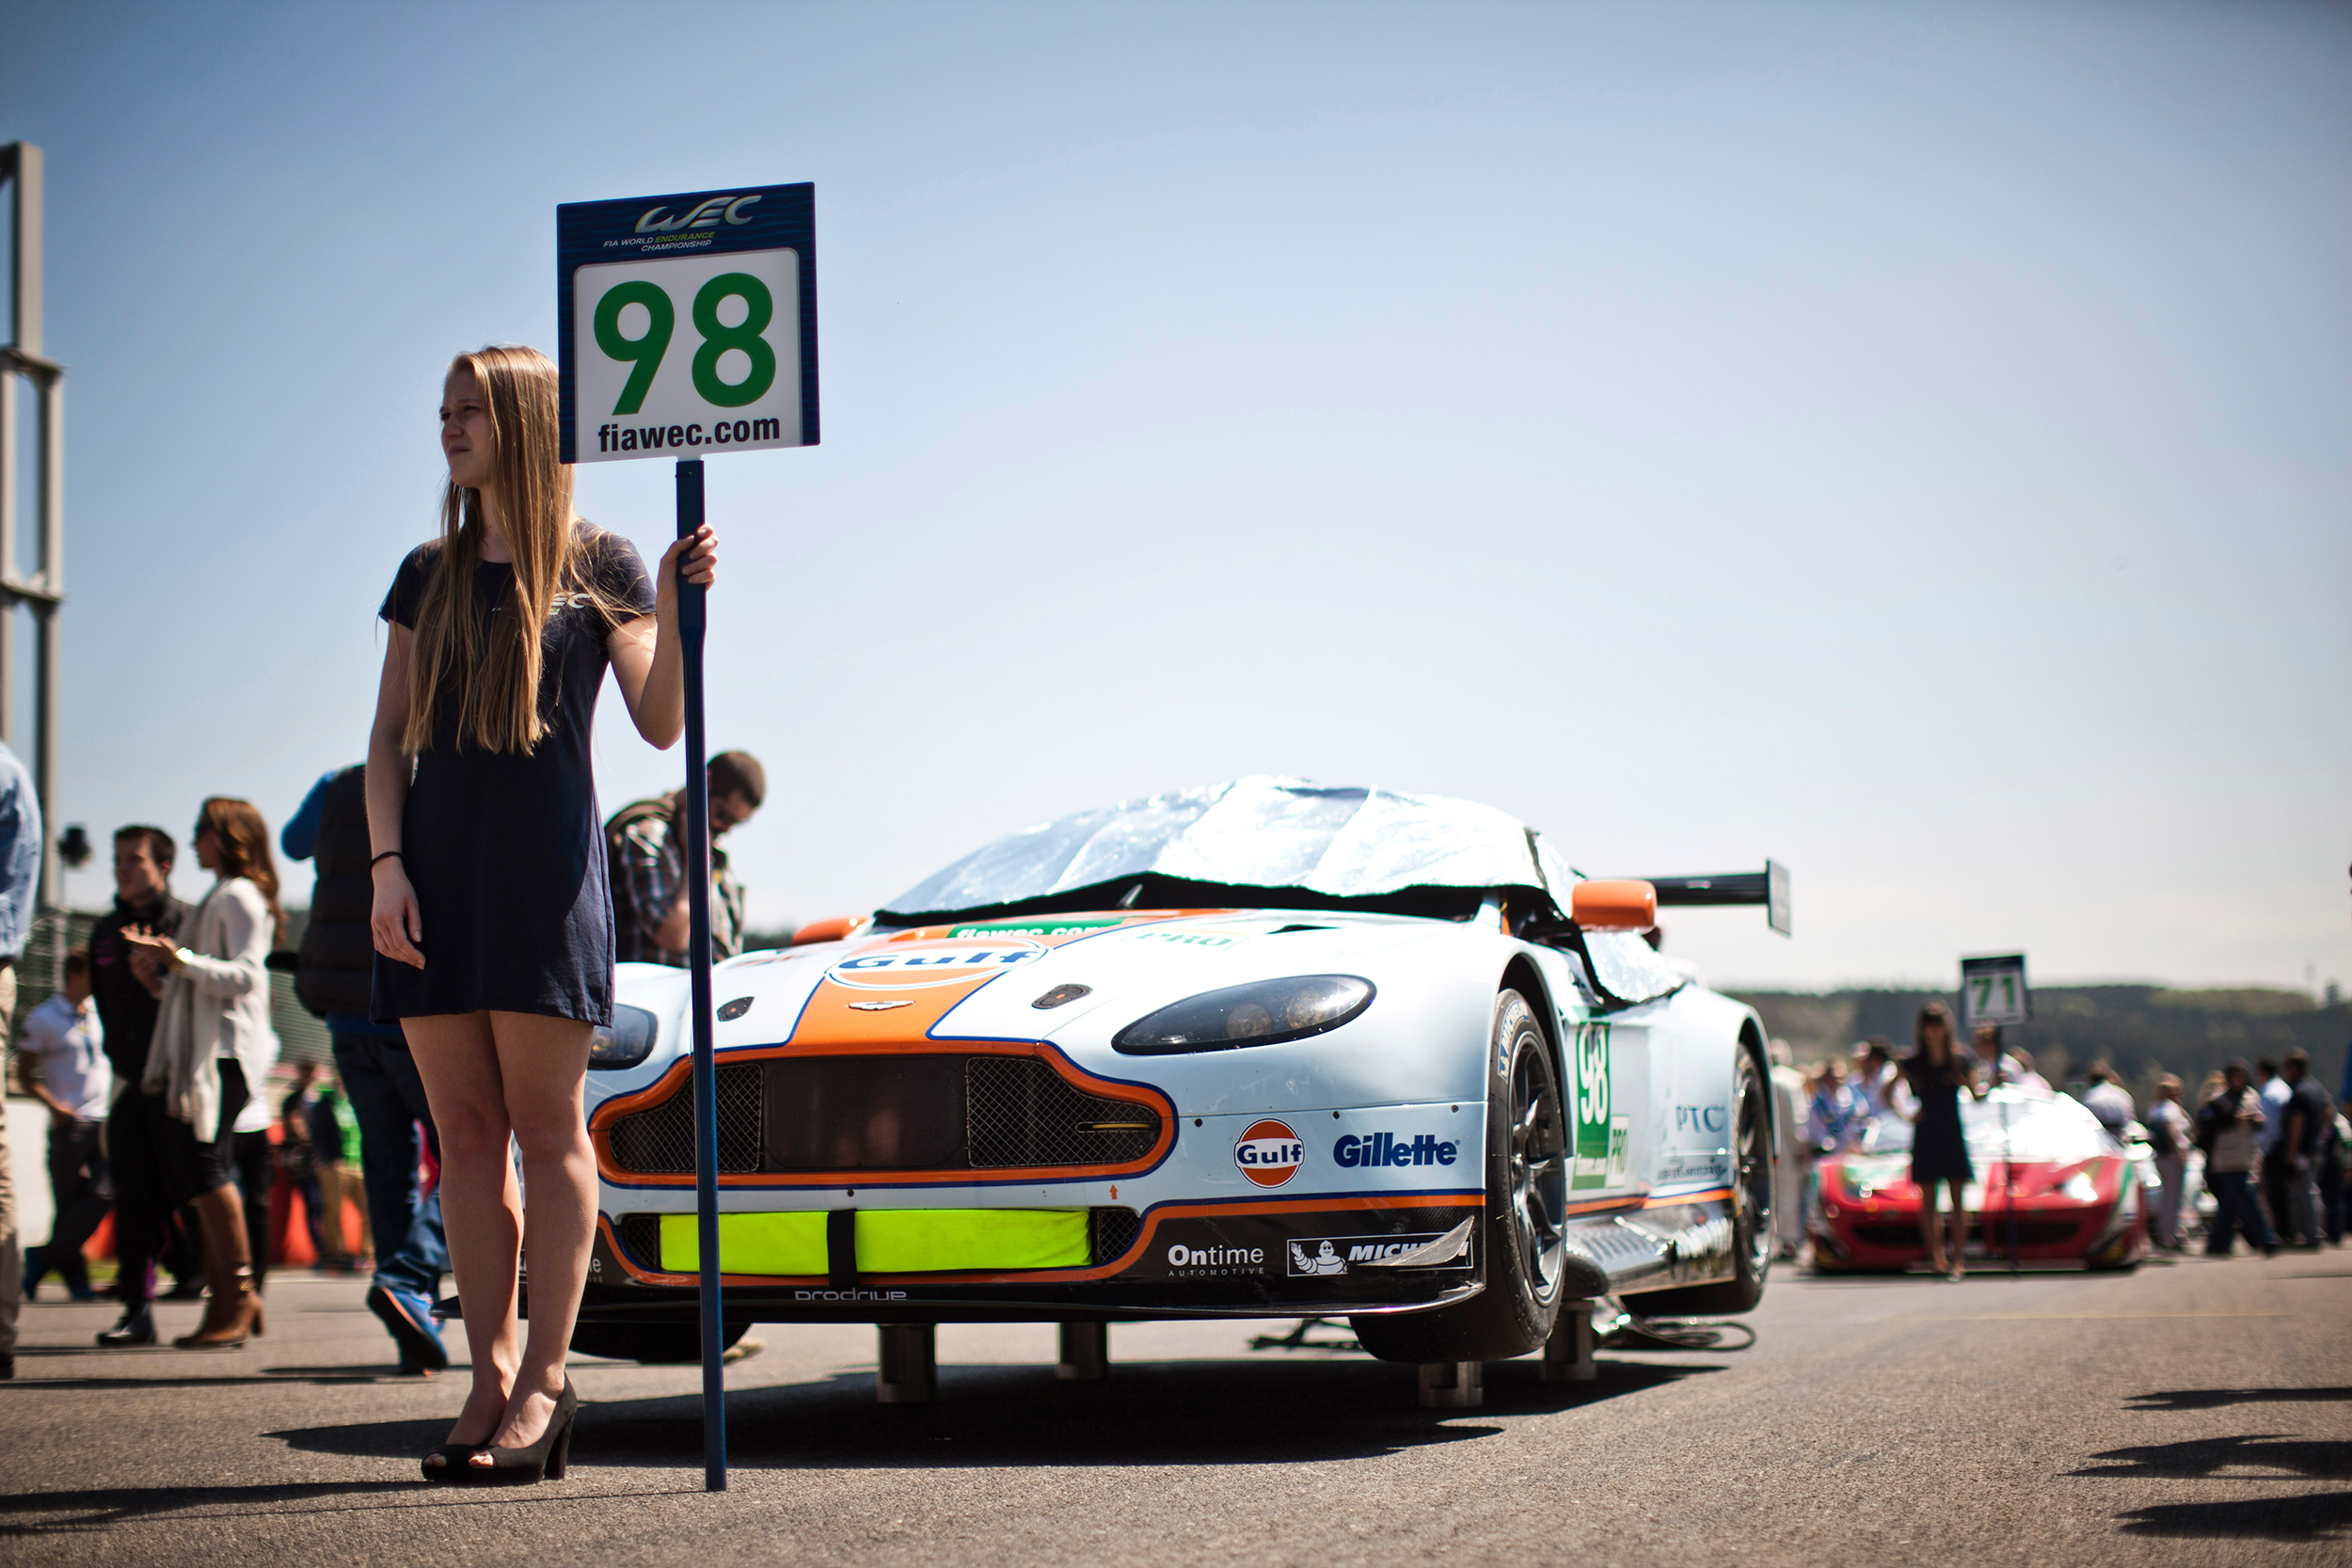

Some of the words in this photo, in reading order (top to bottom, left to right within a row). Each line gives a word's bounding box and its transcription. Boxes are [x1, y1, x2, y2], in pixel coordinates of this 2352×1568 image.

[635, 195, 762, 233] WEC
[603, 240, 619, 248] FIA
[621, 237, 654, 246] WORLD
[655, 230, 716, 244] ENDURANCE
[641, 239, 712, 252] CHAMPIONSHIP
[594, 273, 777, 416] 98
[598, 417, 781, 452] fiawec.com
[1135, 932, 1232, 946] PRO
[838, 951, 1040, 970] Gulf
[1970, 975, 2015, 1012] 71
[1579, 1022, 1608, 1125] 98
[1236, 1144, 1302, 1164] Gulf
[1333, 1132, 1457, 1168] Gillette
[1168, 1244, 1264, 1266] Ontime
[1347, 1241, 1469, 1261] MICH
[1168, 1267, 1264, 1277] AUTOMOTIVE
[794, 1287, 907, 1301] prodrive
